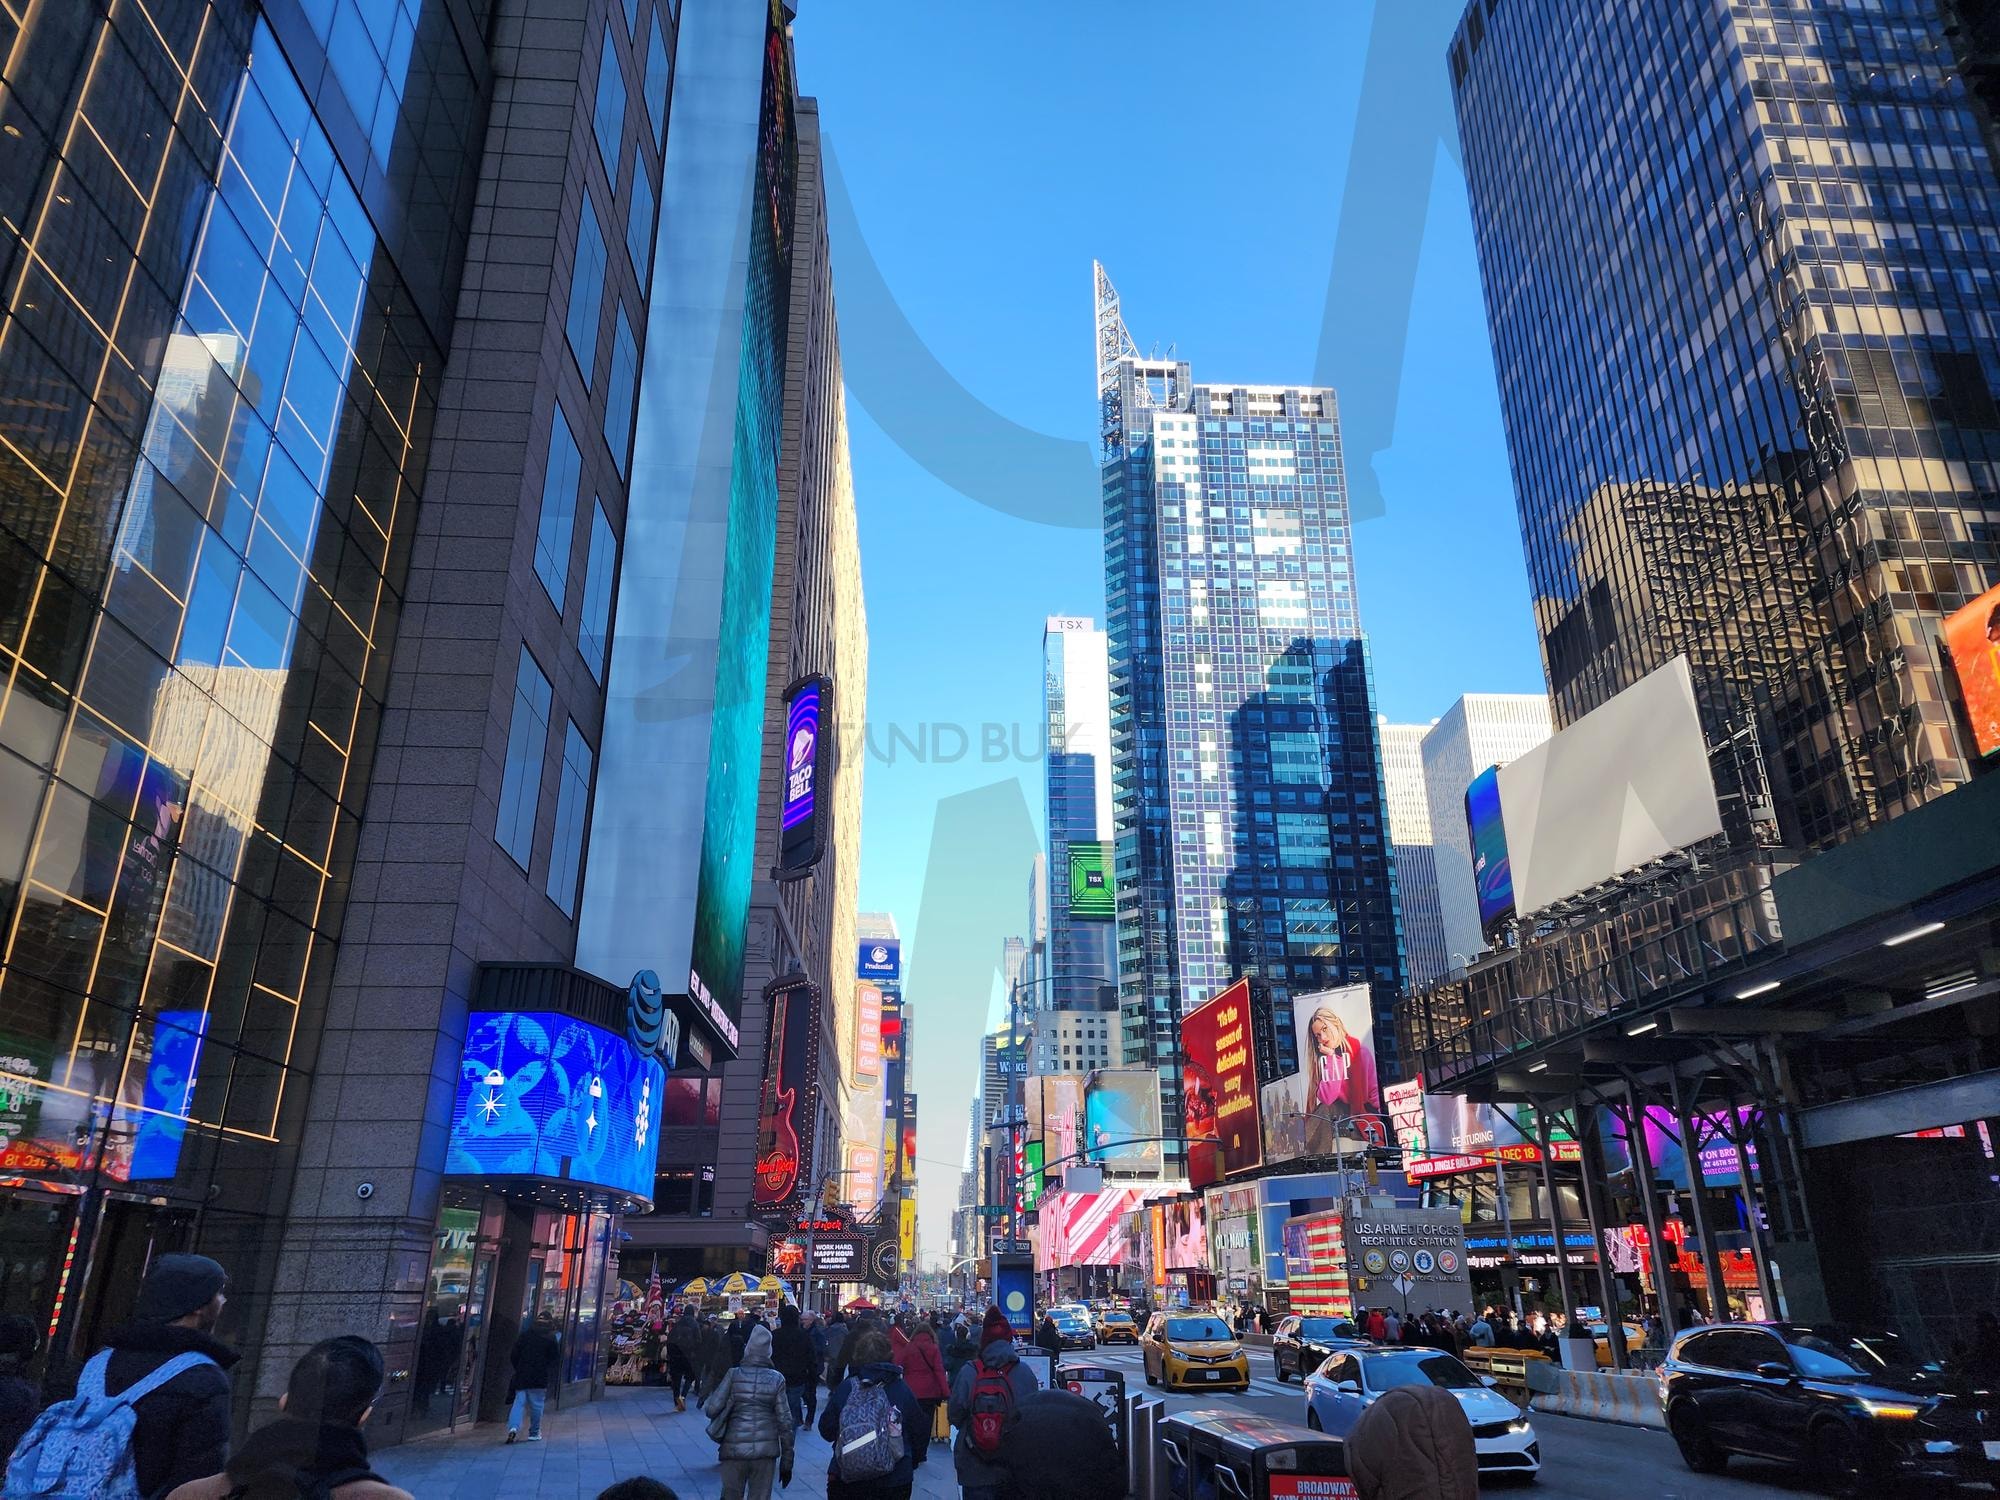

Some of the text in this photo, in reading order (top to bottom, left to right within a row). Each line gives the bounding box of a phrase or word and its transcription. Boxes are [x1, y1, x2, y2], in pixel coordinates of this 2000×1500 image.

[1058, 620, 1082, 630] TSX
[789, 765, 812, 789] TACO
[790, 780, 812, 803] BELL
[1216, 1024, 1242, 1052] season of
[1216, 1045, 1247, 1074] deliciously
[1320, 1052, 1351, 1082] GAP
[1224, 1074, 1241, 1093] saucy
[1452, 1130, 1494, 1148] FEATURING
[757, 1158, 795, 1175] Hard Rock
[1415, 1162, 1434, 1175] RADIO
[1434, 1159, 1456, 1172] JINGLE
[1455, 1156, 1470, 1169] BALL
[1504, 1149, 1522, 1161] DEC
[1524, 1147, 1535, 1159] 18
[1354, 1223, 1461, 1235] U.S. ARMED FORCES
[1230, 1231, 1250, 1249] NAVY
[1361, 1236, 1457, 1247] RECRUITING STATION
[1480, 1257, 1494, 1268] pay
